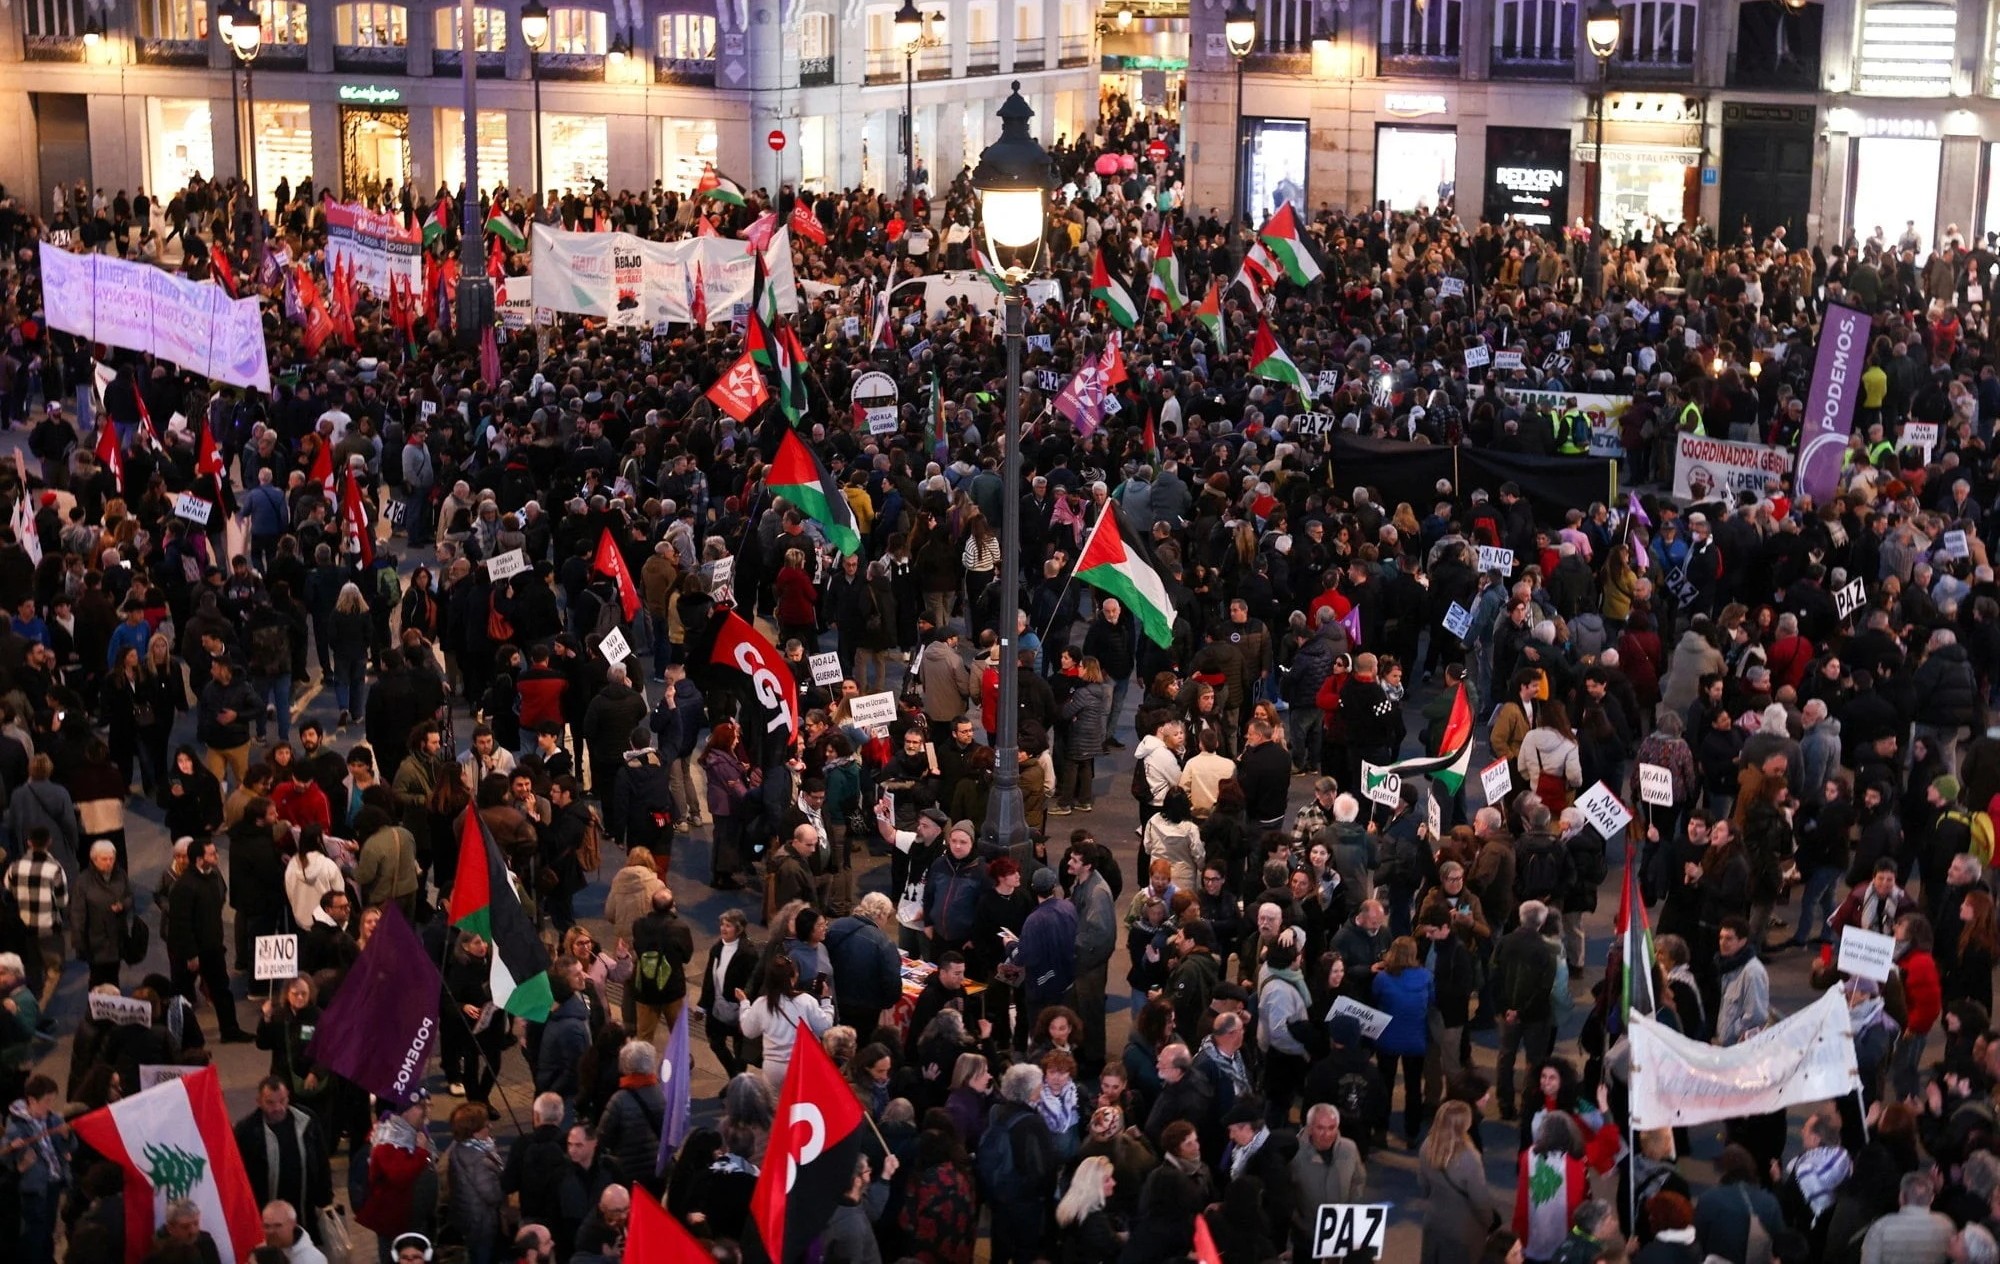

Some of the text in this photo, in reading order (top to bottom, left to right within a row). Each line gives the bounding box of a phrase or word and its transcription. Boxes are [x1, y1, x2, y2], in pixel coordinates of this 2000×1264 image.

[1496, 167, 1563, 187] REDKEN
[614, 255, 642, 268] ABAJO
[1040, 373, 1058, 390] PAZ
[1320, 371, 1337, 386] PAZ
[1681, 438, 1758, 470] COORDINADORA
[182, 502, 209, 521] WAR!
[189, 497, 205, 508] NO
[1493, 549, 1512, 566] NO
[1837, 580, 1865, 617] PAZ
[606, 634, 618, 649] NO
[811, 654, 837, 669] ¡NO A LA
[815, 668, 841, 682] GUERRA!
[733, 641, 793, 734] CGT
[1372, 789, 1398, 804] guerra
[1601, 795, 1621, 816] NO
[1586, 798, 1618, 833] WAR!
[273, 938, 295, 960] NO
[1316, 1207, 1384, 1258] PAZ
